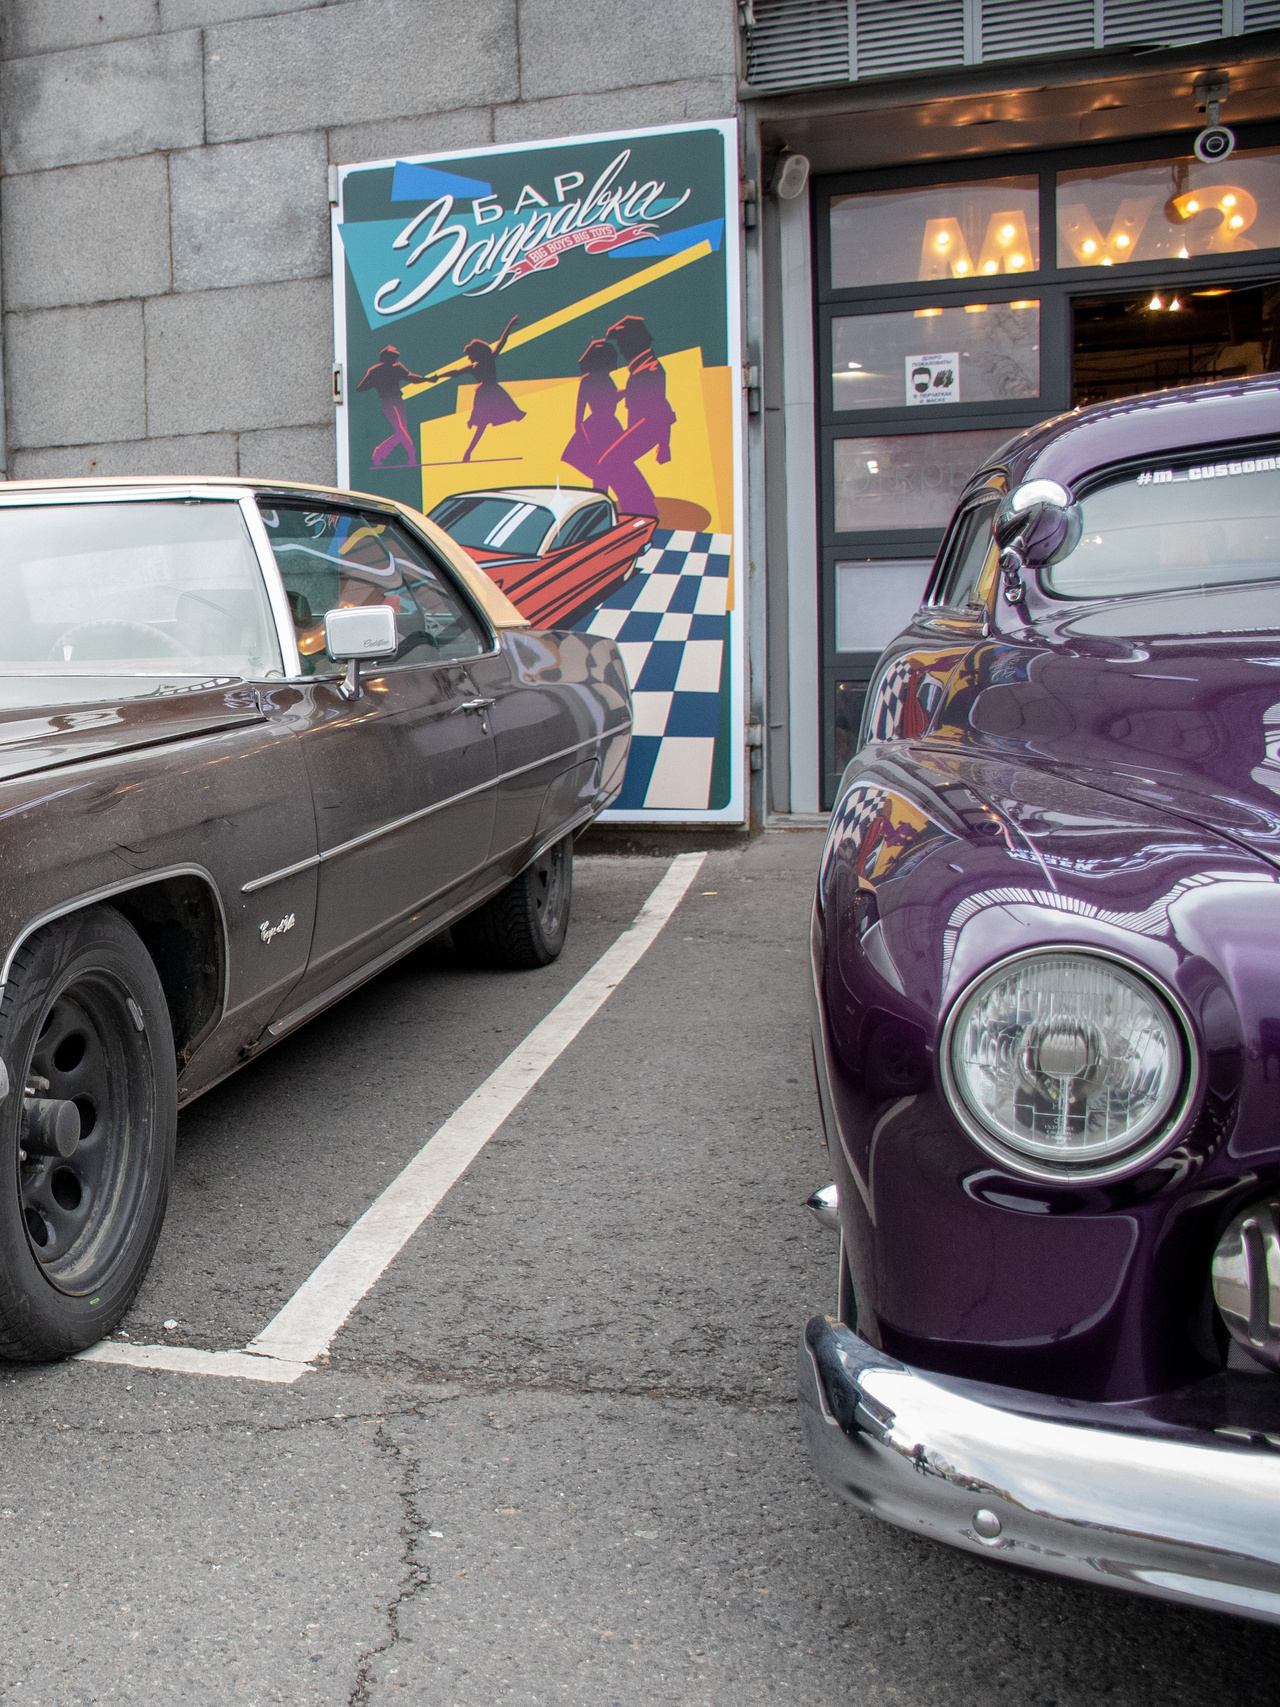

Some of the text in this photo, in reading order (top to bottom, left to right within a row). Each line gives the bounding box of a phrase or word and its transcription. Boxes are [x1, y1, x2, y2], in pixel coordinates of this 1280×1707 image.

[471, 171, 585, 226] БАР
[373, 148, 692, 315] Заправка
[528, 227, 612, 262] BIG BOYS BIG TOYS
